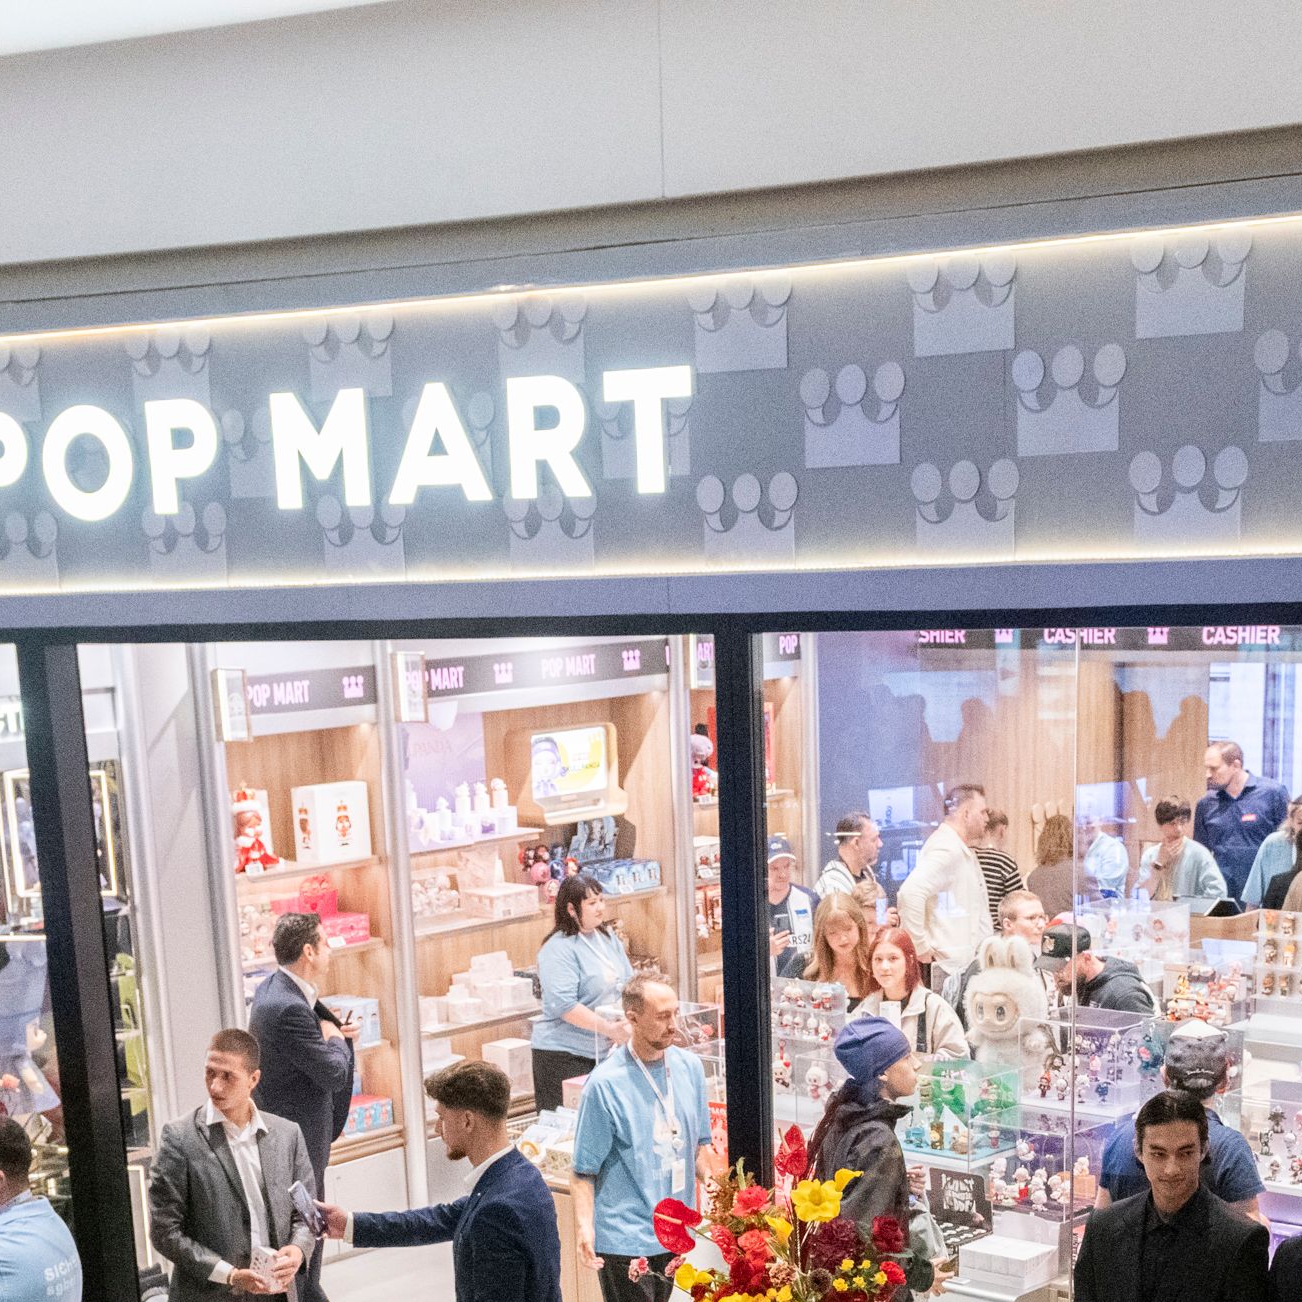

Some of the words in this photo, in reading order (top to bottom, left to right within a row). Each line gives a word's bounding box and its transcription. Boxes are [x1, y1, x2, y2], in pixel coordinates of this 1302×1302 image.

[269, 364, 692, 510] MART
[779, 635, 798, 655] POP
[918, 629, 966, 644] SHIER
[1043, 628, 1117, 645] CASHIER
[1202, 625, 1280, 645] CASHIER
[541, 656, 562, 679] POP
[565, 653, 596, 677] MART
[430, 666, 464, 691] MART
[273, 680, 310, 706] MART
